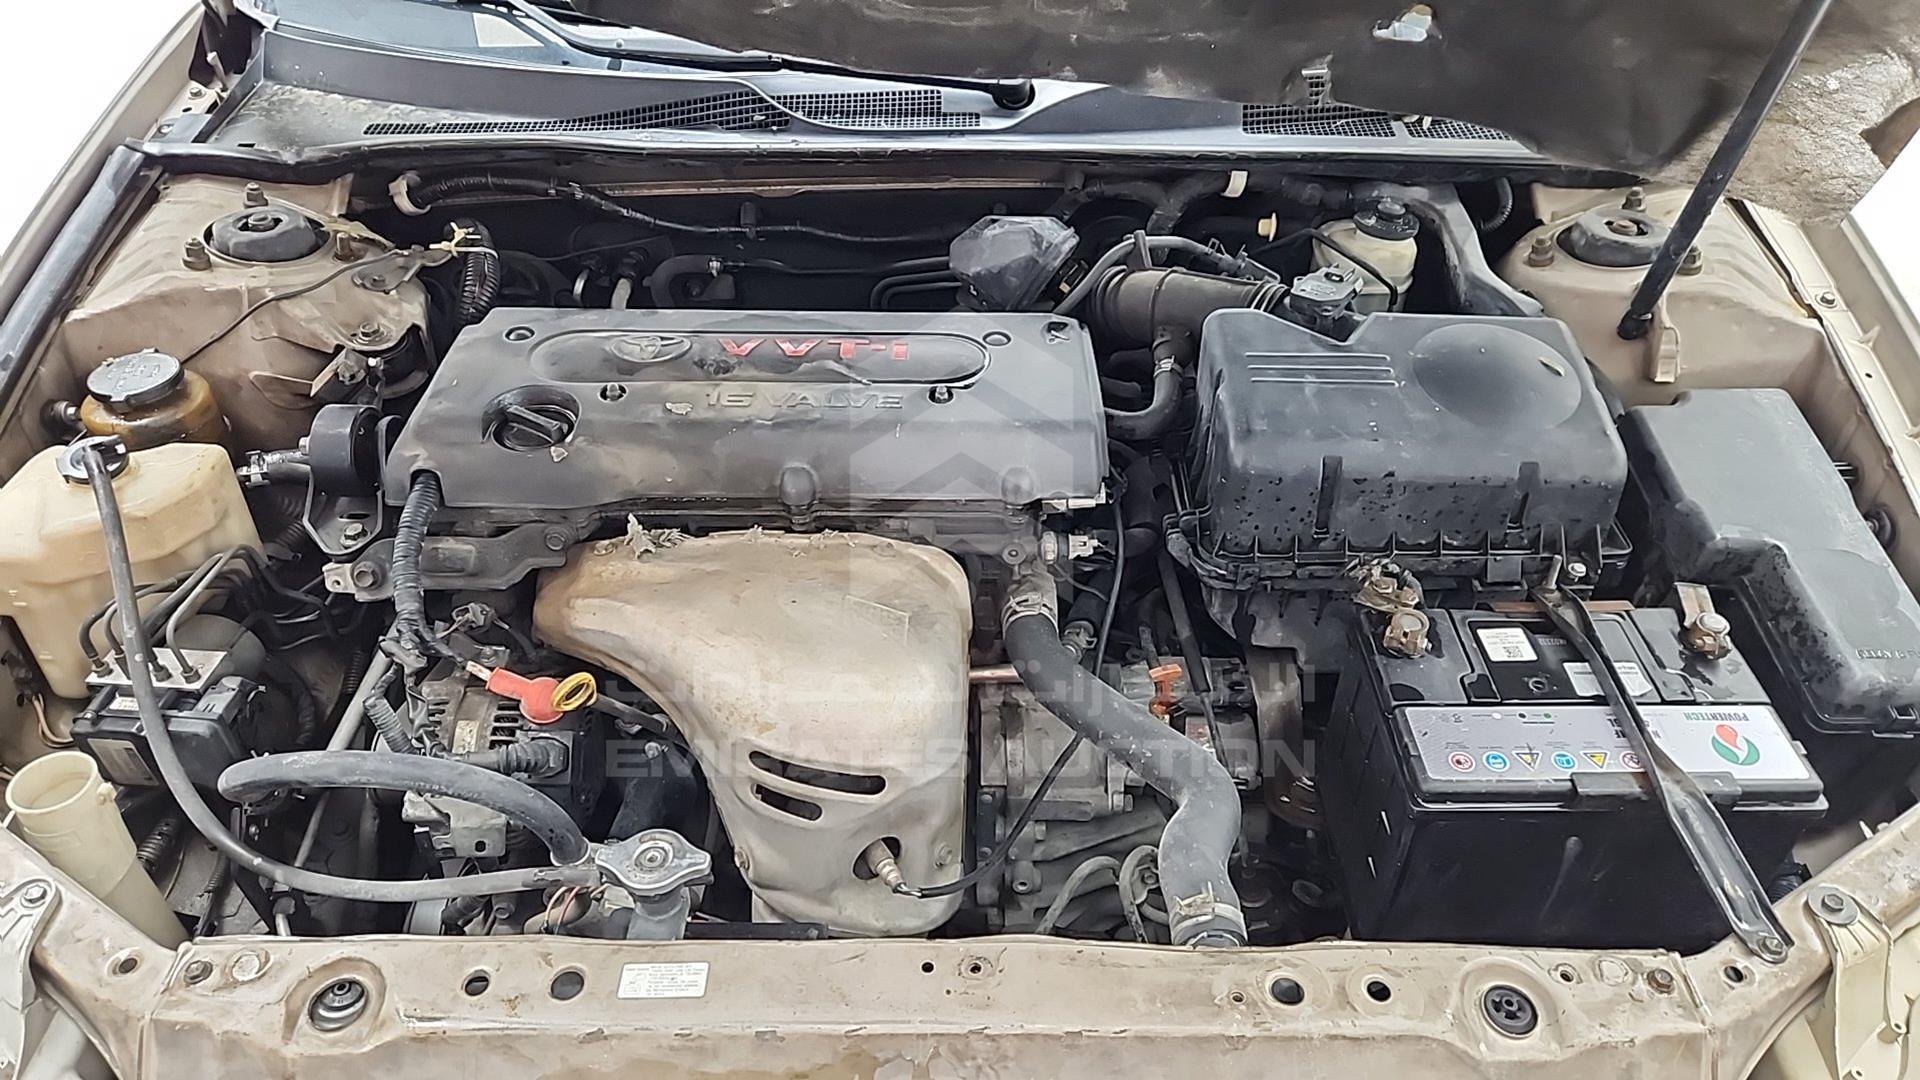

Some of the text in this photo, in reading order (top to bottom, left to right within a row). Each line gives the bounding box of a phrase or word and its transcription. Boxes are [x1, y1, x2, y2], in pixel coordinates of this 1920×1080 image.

[706, 385, 904, 409] 16 VALVE
[1683, 711, 1750, 722] POWERTECH
